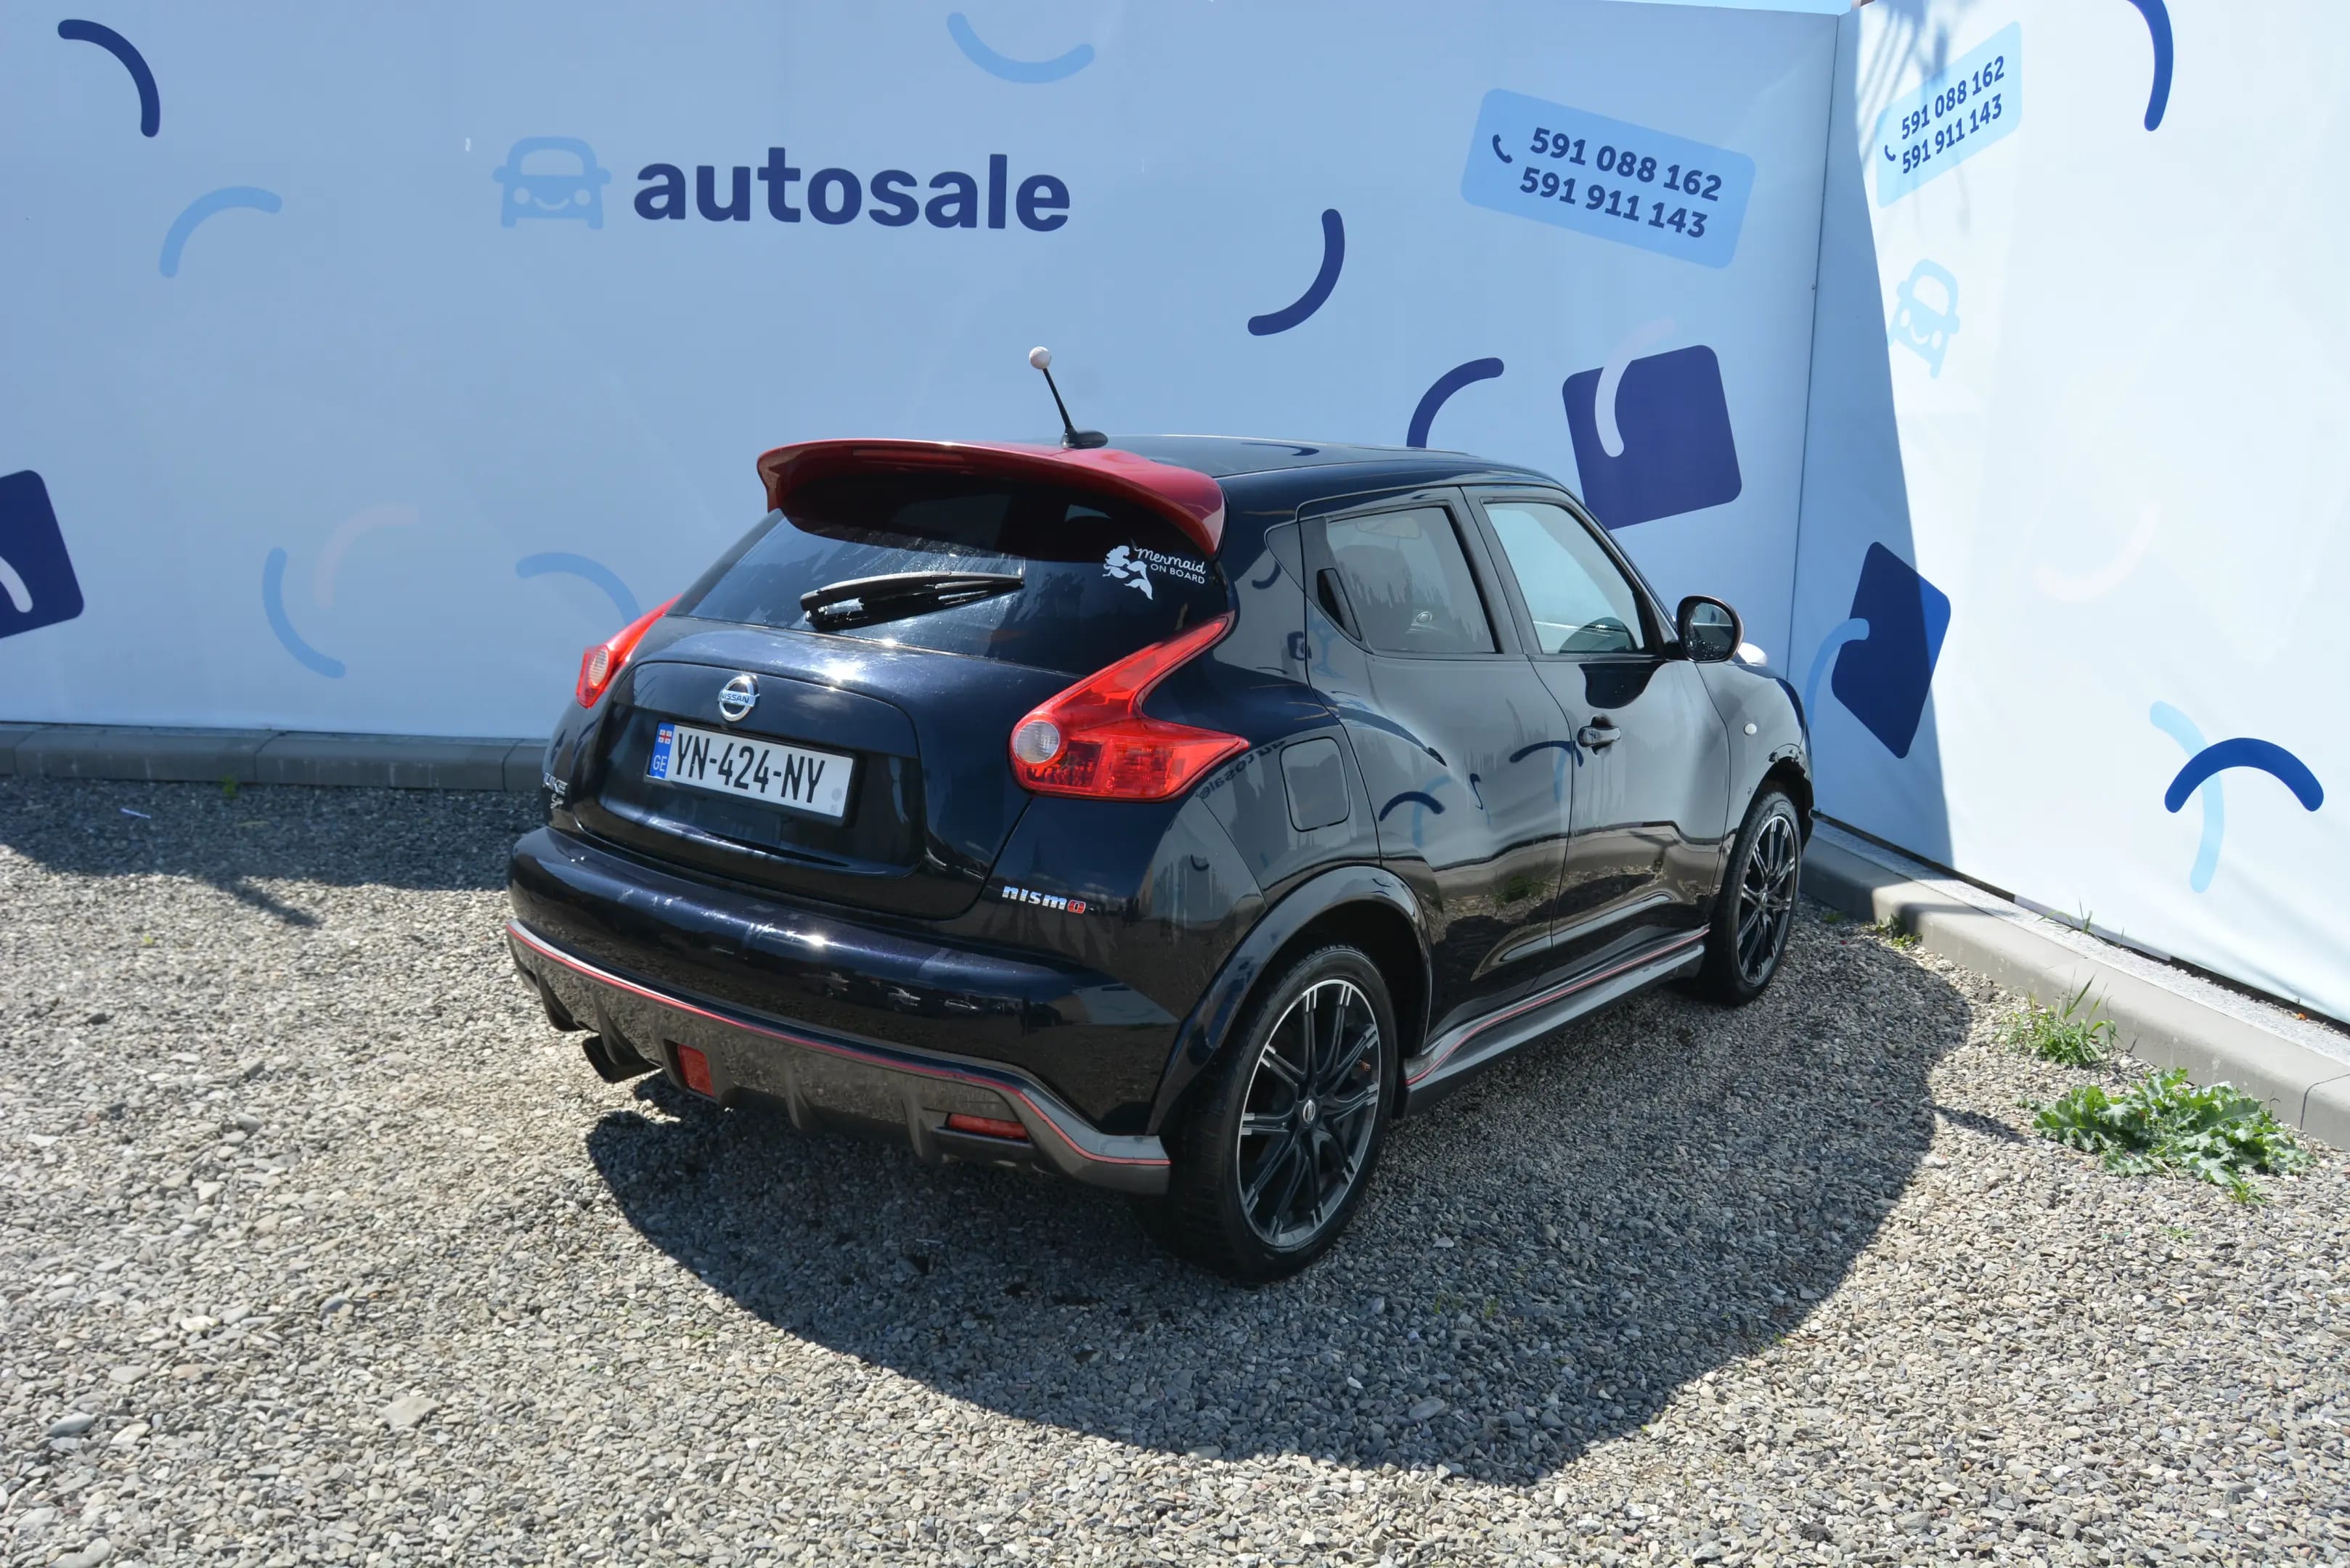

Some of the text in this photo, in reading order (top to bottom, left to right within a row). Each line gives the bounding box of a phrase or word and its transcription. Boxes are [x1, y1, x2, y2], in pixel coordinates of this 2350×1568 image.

[1901, 55, 2004, 139] 591 088 162
[1902, 93, 2002, 173] 591 911 143
[634, 147, 1070, 232] autosale
[1530, 127, 1722, 201] 591 088 162
[1519, 166, 1708, 238] 591 911 143
[1150, 563, 1205, 584] ON BOARD
[720, 691, 750, 704] NISSAN
[653, 754, 668, 772] GE
[676, 732, 825, 804] YN-424-NY
[1001, 886, 1086, 915] nismo
